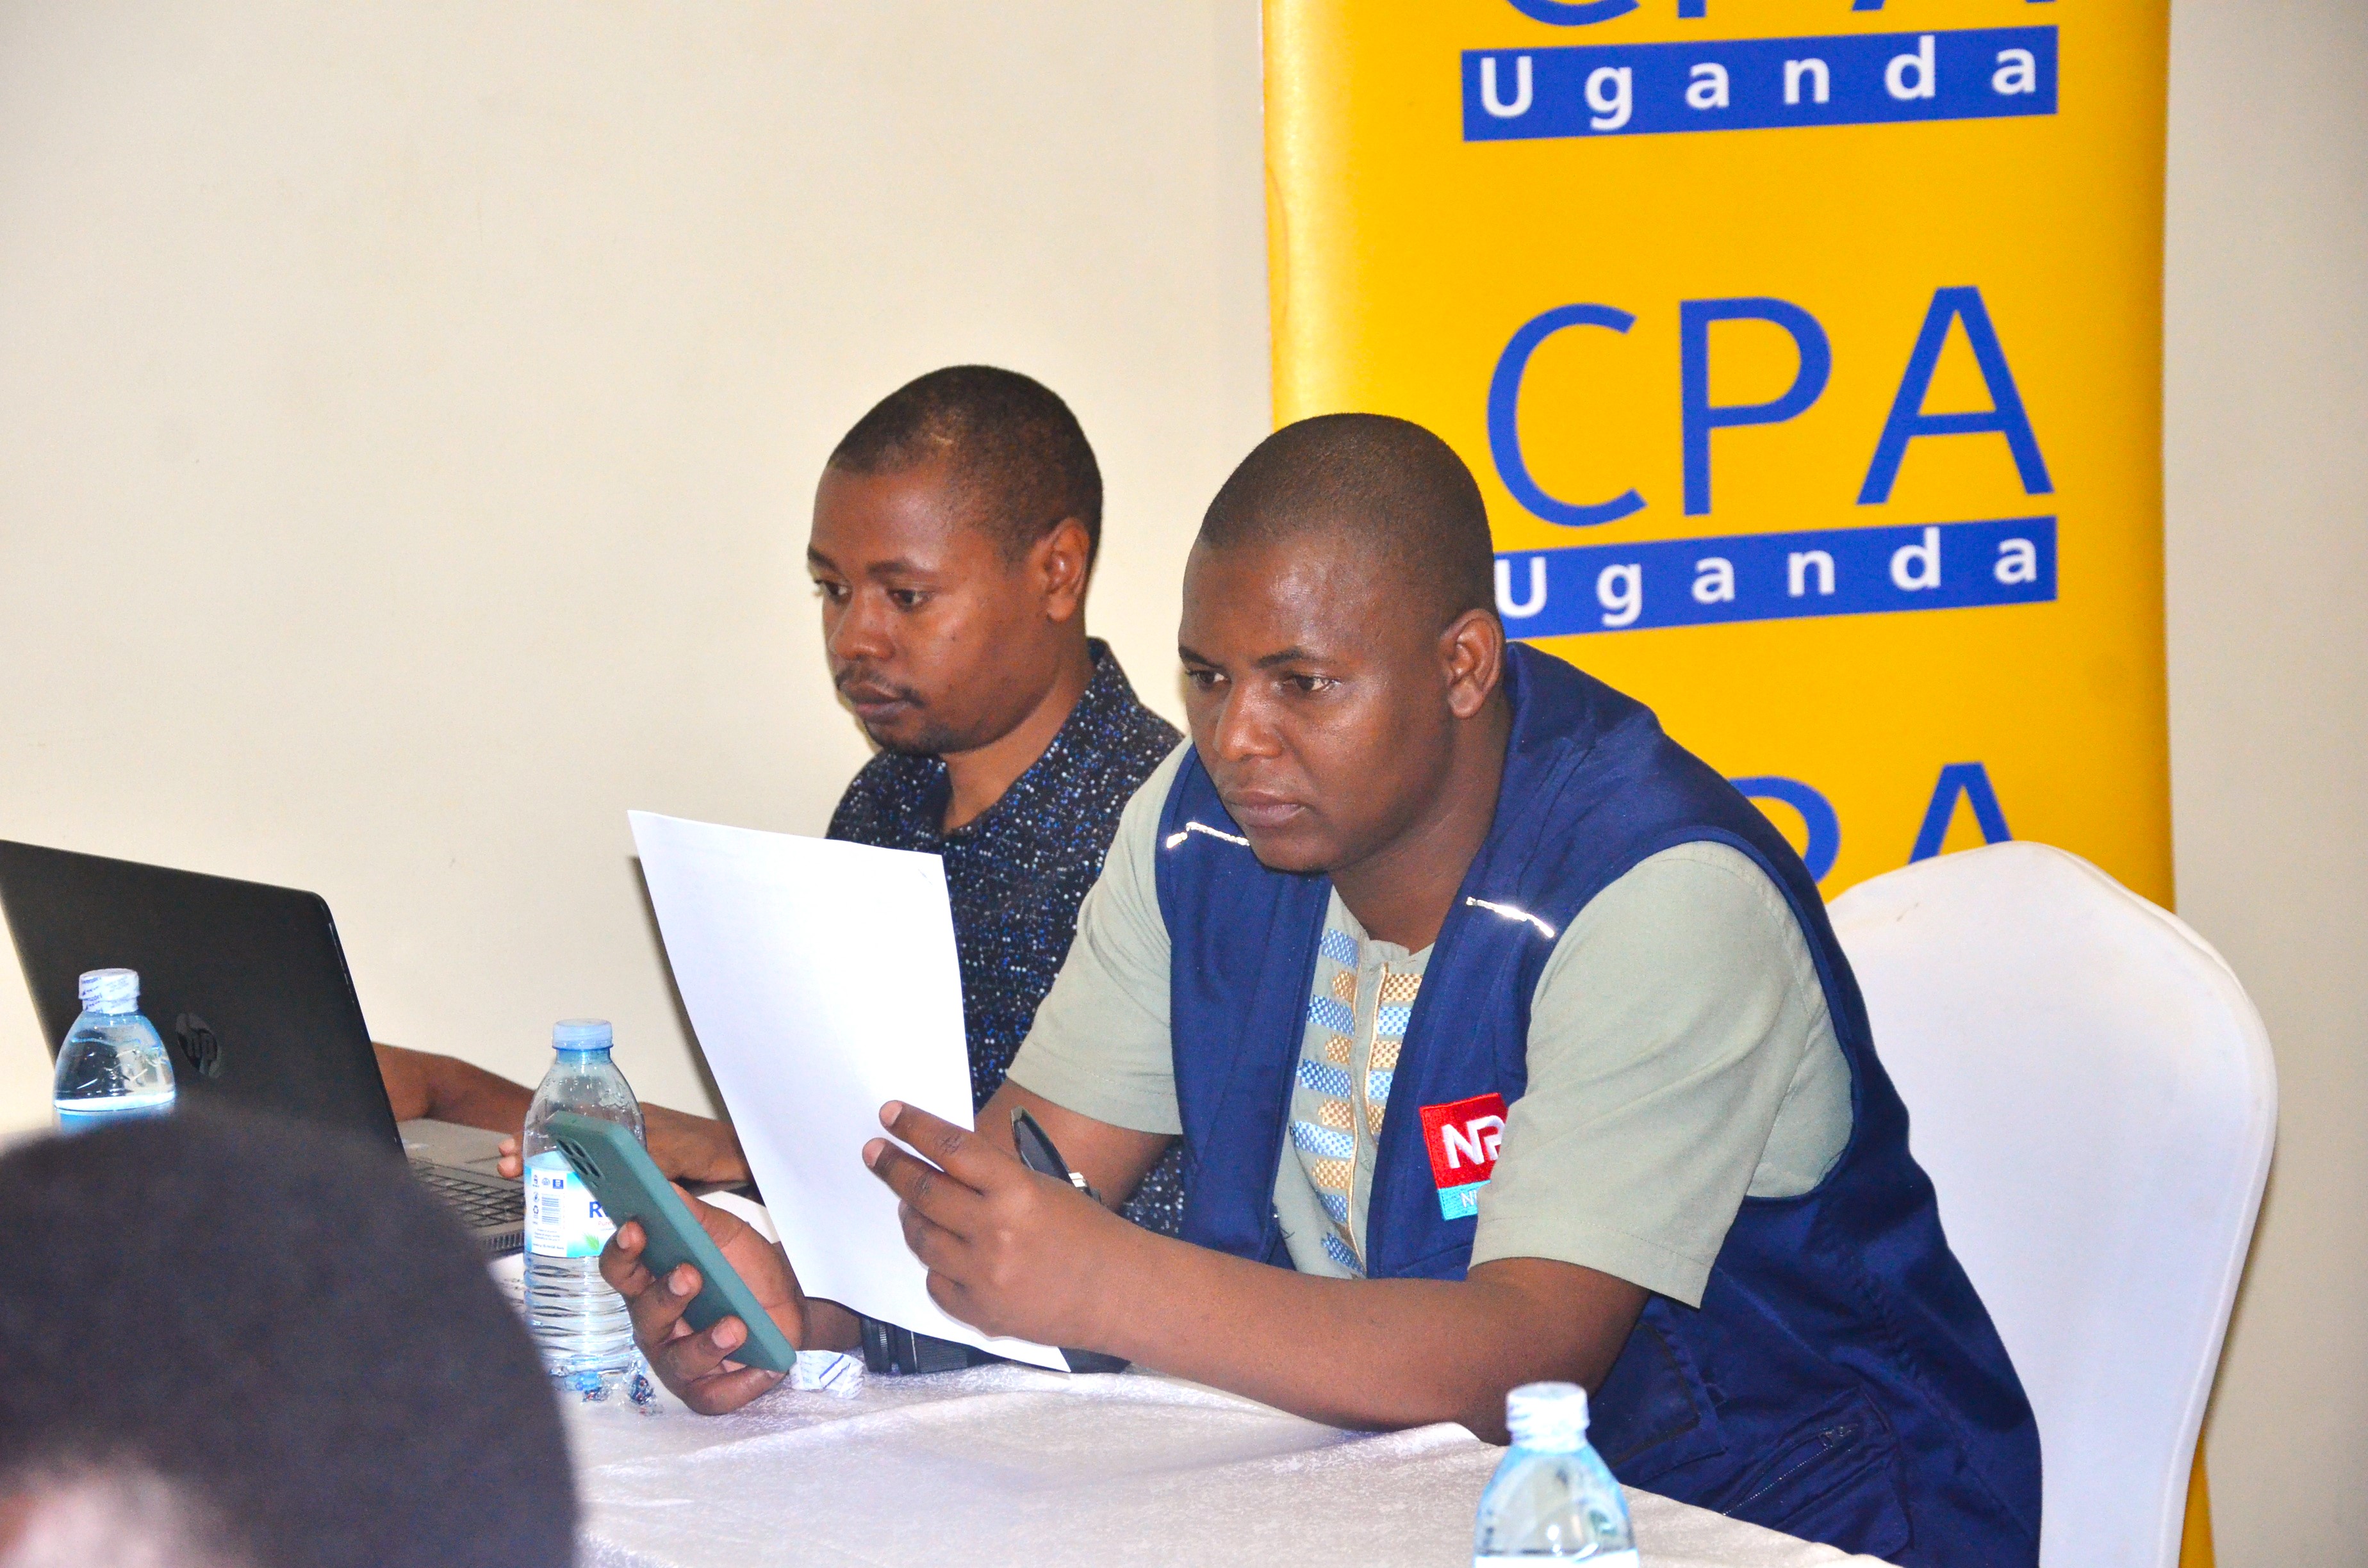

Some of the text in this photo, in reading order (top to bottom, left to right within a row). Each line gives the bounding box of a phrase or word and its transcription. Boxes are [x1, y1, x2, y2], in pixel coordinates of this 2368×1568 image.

[1479, 34, 2037, 131] Uganda
[1486, 284, 2055, 528] CPA
[1494, 526, 2038, 626] Uganda
